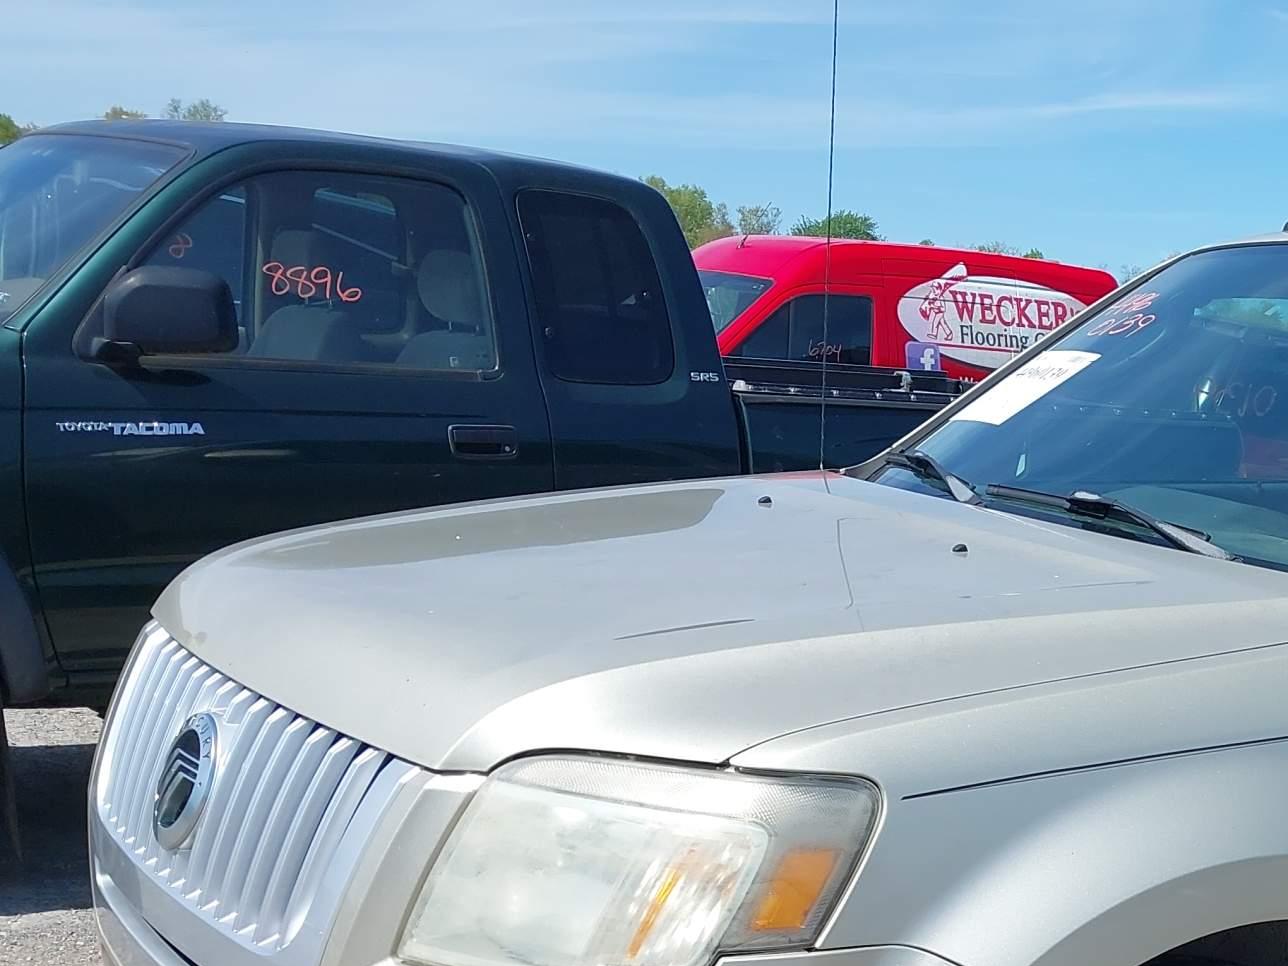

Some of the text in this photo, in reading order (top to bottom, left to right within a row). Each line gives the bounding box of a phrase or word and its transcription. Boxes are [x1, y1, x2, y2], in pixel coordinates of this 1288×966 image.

[262, 262, 362, 301] 8896
[959, 325, 1029, 350] Flooring
[690, 371, 720, 382] SR5
[56, 422, 206, 435] TOYOTA TACOMA
